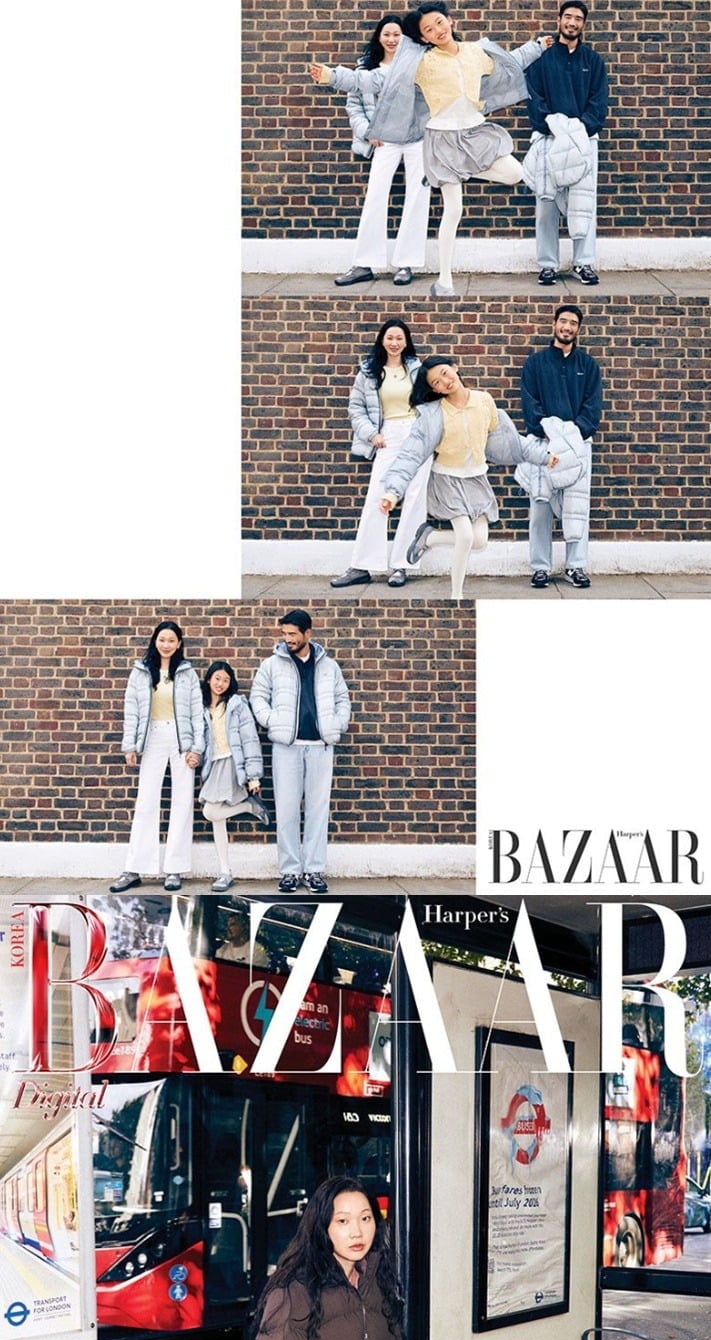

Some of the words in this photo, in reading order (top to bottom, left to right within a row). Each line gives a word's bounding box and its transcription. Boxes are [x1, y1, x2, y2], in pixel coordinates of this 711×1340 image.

[317, 1003, 329, 1014] an
[294, 1030, 313, 1045] bus
[501, 1184, 523, 1195] fares
[504, 1197, 521, 1210] July
[33, 1296, 67, 1306] TRANSPORT
[33, 1306, 45, 1314] FOR
[46, 1303, 71, 1313] LONDON
